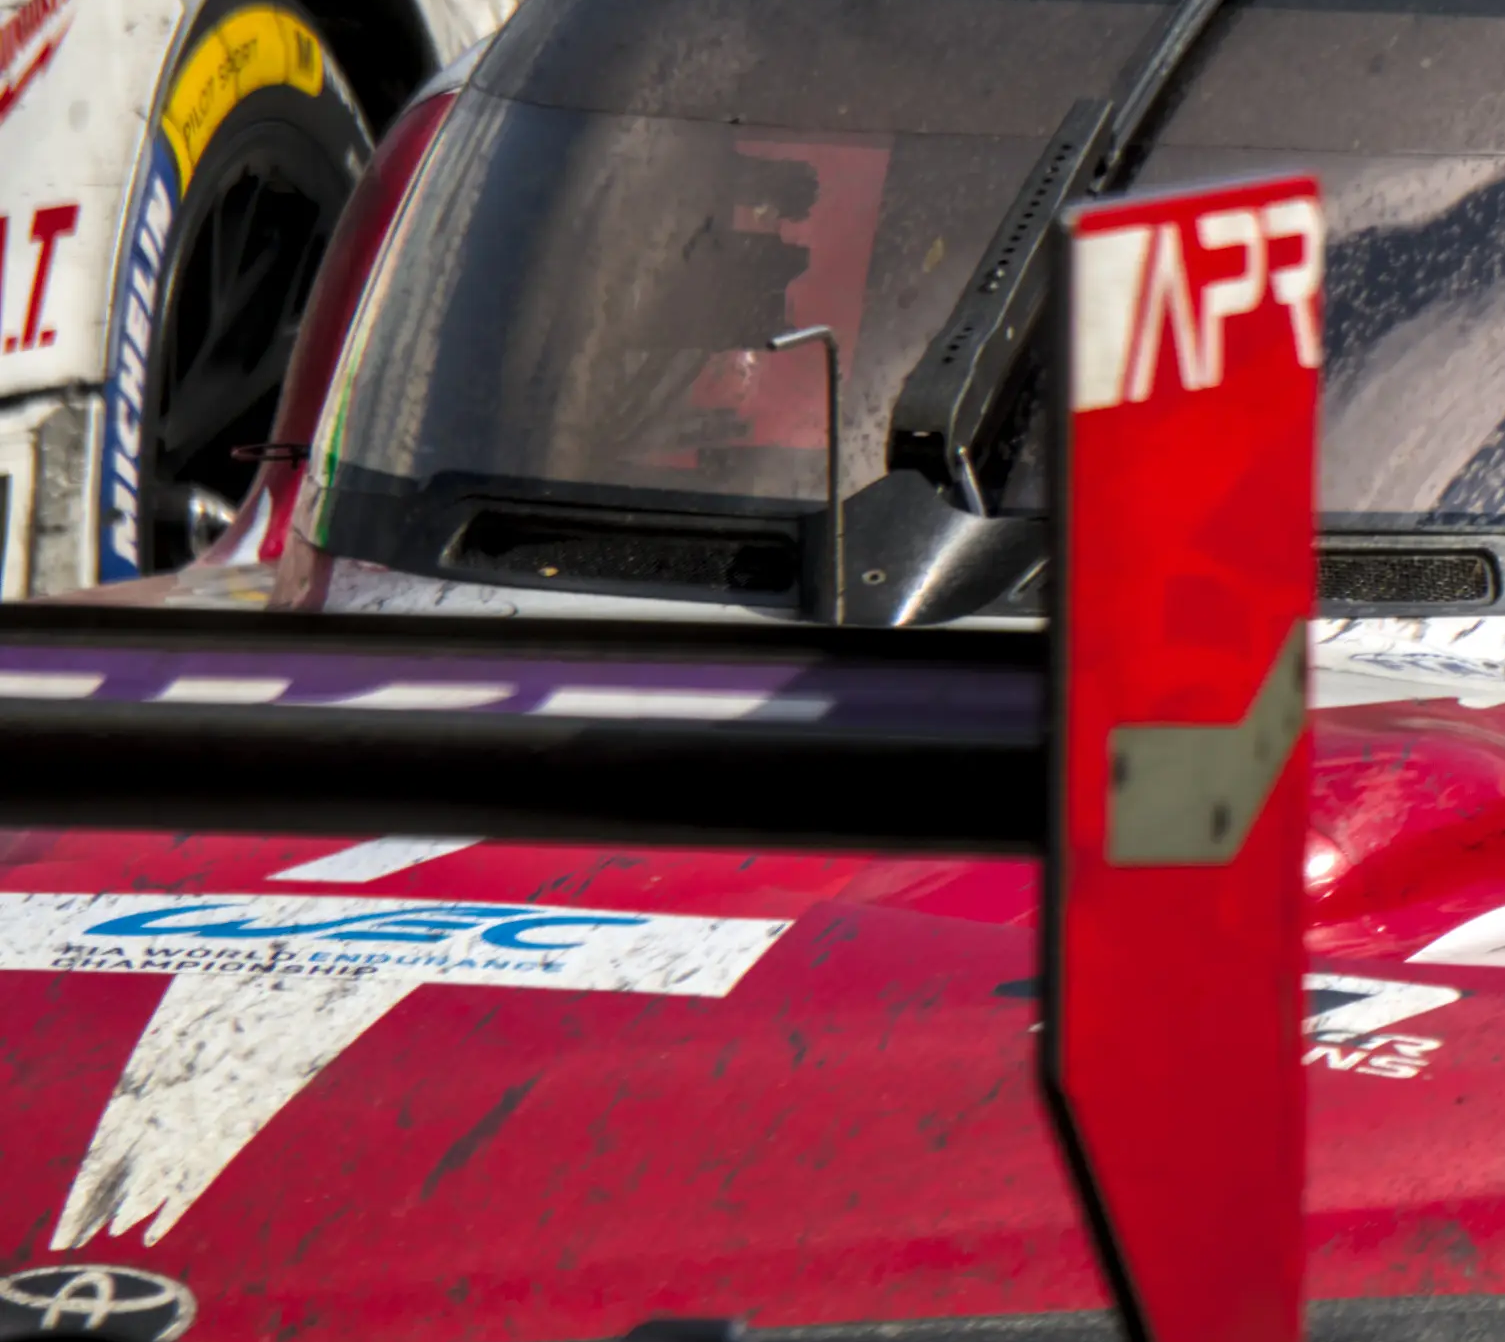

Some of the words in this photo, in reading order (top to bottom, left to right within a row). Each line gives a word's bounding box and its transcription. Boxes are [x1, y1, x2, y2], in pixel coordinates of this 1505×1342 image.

[181, 76, 221, 148] PILOT
[217, 34, 261, 83] SPORT
[111, 171, 176, 567] MICHELIN
[83, 903, 650, 952] WEC
[50, 957, 380, 976] CHAMPIONSHIP
[55, 942, 125, 957] FIA
[147, 946, 298, 961] WORLD
[307, 949, 566, 974] ENDURANCE
